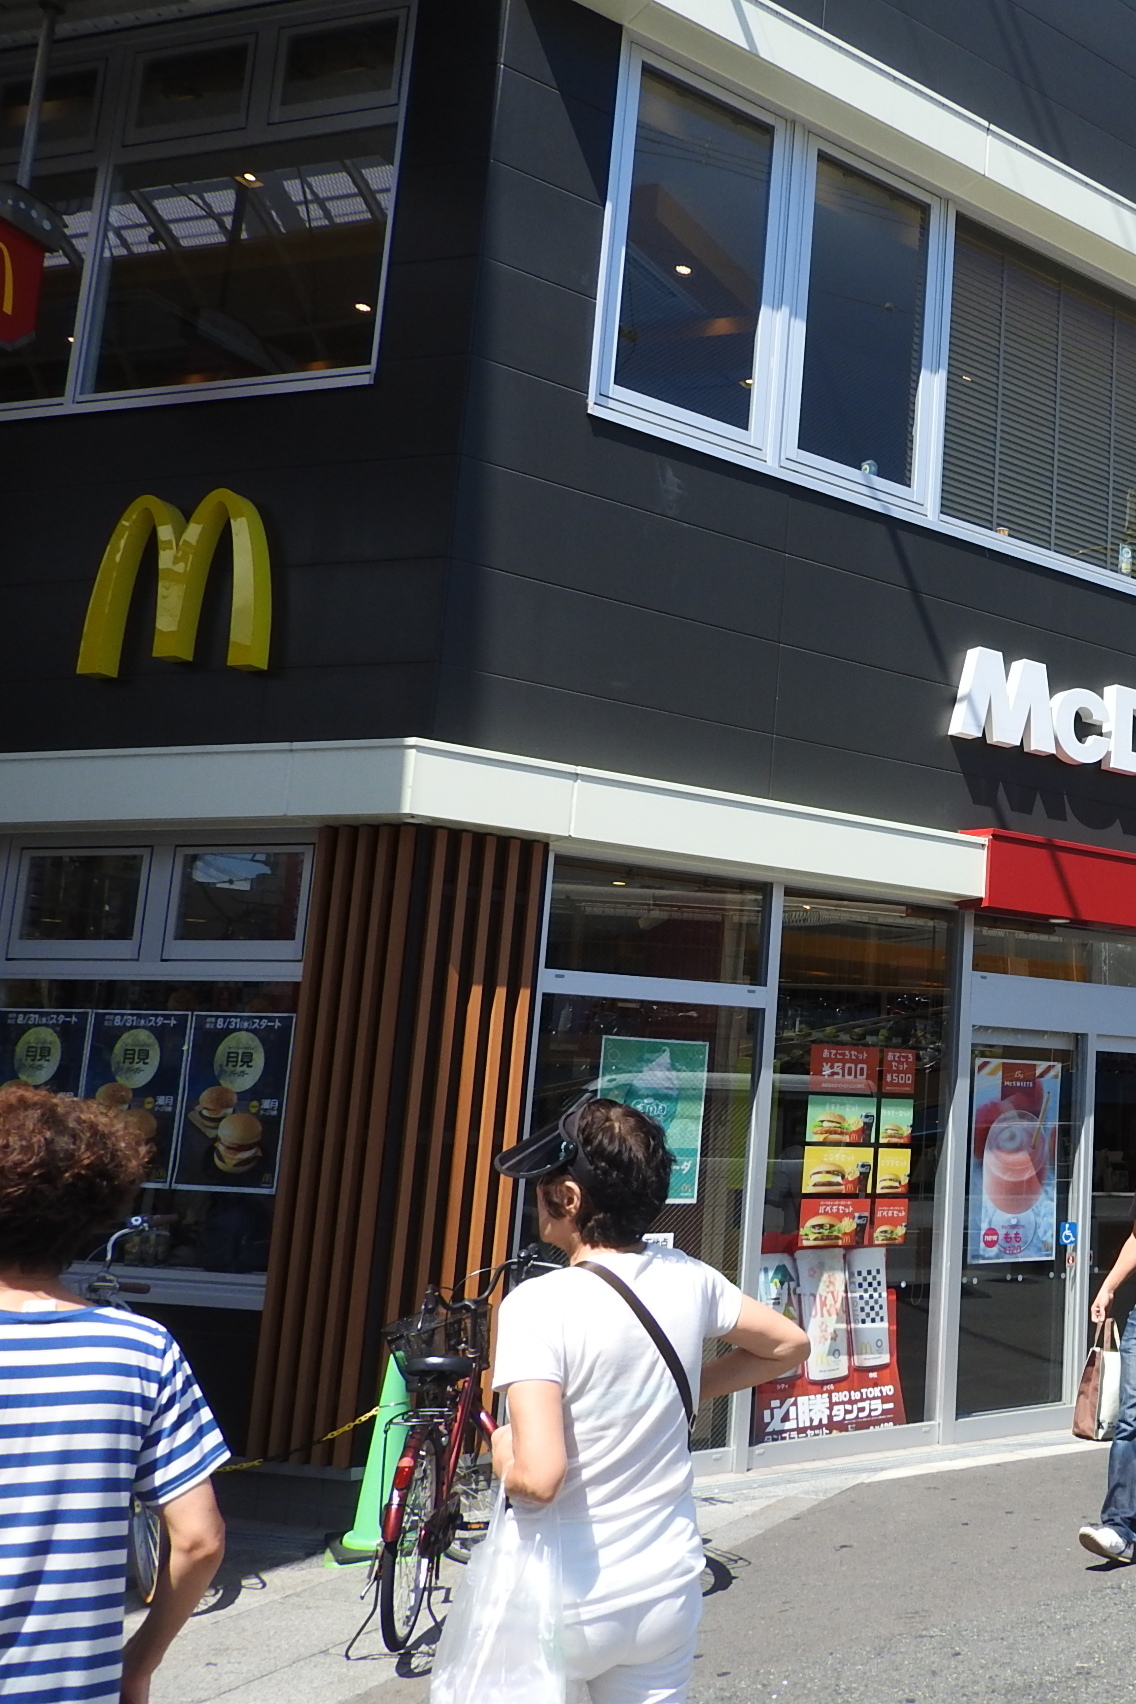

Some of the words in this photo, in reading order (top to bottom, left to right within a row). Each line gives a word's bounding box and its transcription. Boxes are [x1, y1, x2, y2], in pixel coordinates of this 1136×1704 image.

[216, 1017, 282, 1029] 8/31(水)スタート
[25, 1046, 52, 1062] 月見
[122, 1048, 151, 1065] 月見
[225, 1051, 254, 1069] 月見
[822, 1048, 868, 1060] おてごろセット
[887, 1051, 913, 1062] おてごろ
[821, 1062, 868, 1080] ¥500
[891, 1061, 908, 1070] セット
[886, 1073, 912, 1084] ¥500
[1003, 1231, 1022, 1244] もも
[831, 1391, 850, 1403] RIO
[850, 1390, 861, 1400] to
[861, 1385, 895, 1398] TOKYO
[763, 1393, 830, 1432] 必勝
[831, 1398, 895, 1422] タンブラー
